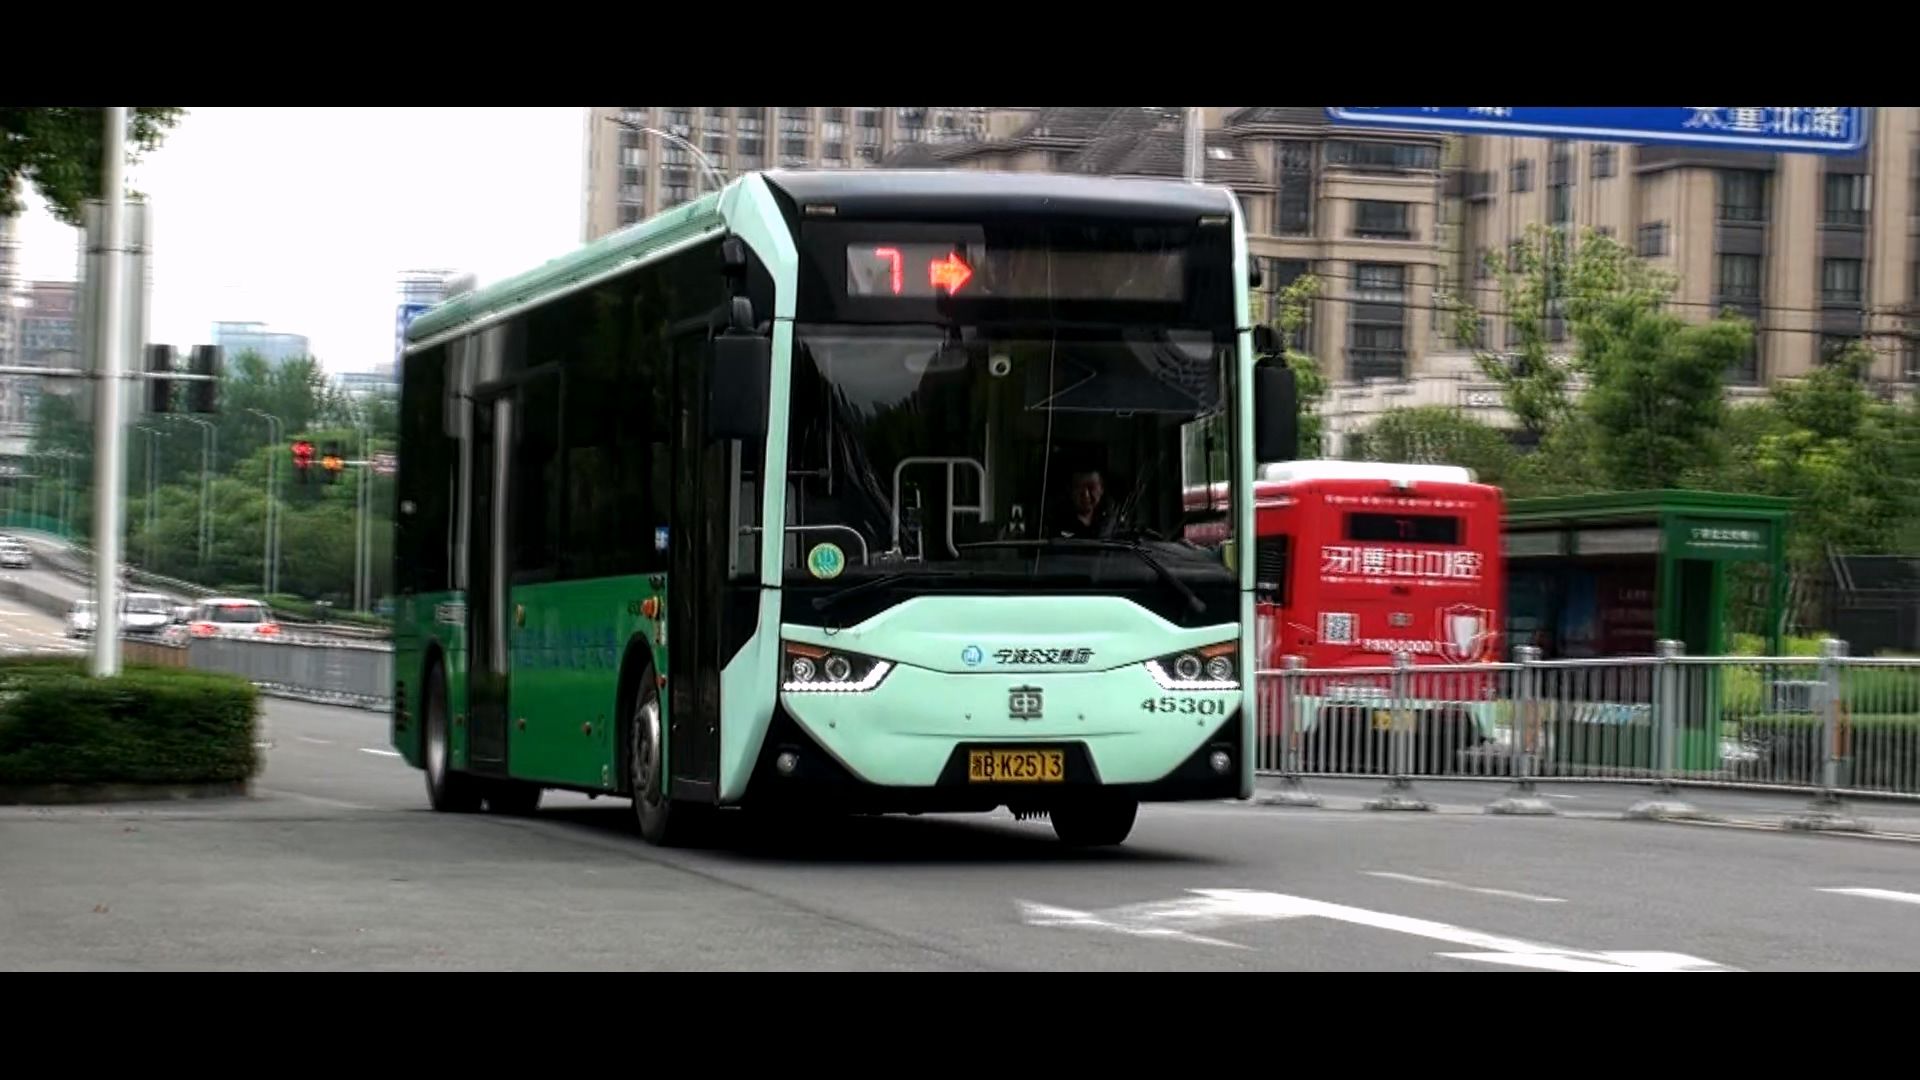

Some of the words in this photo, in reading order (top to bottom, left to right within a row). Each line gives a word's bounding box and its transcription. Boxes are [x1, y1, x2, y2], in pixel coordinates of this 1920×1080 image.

[874, 247, 903, 296] 7
[992, 647, 1096, 665] 宁波公交集团
[1141, 696, 1226, 717] 45301
